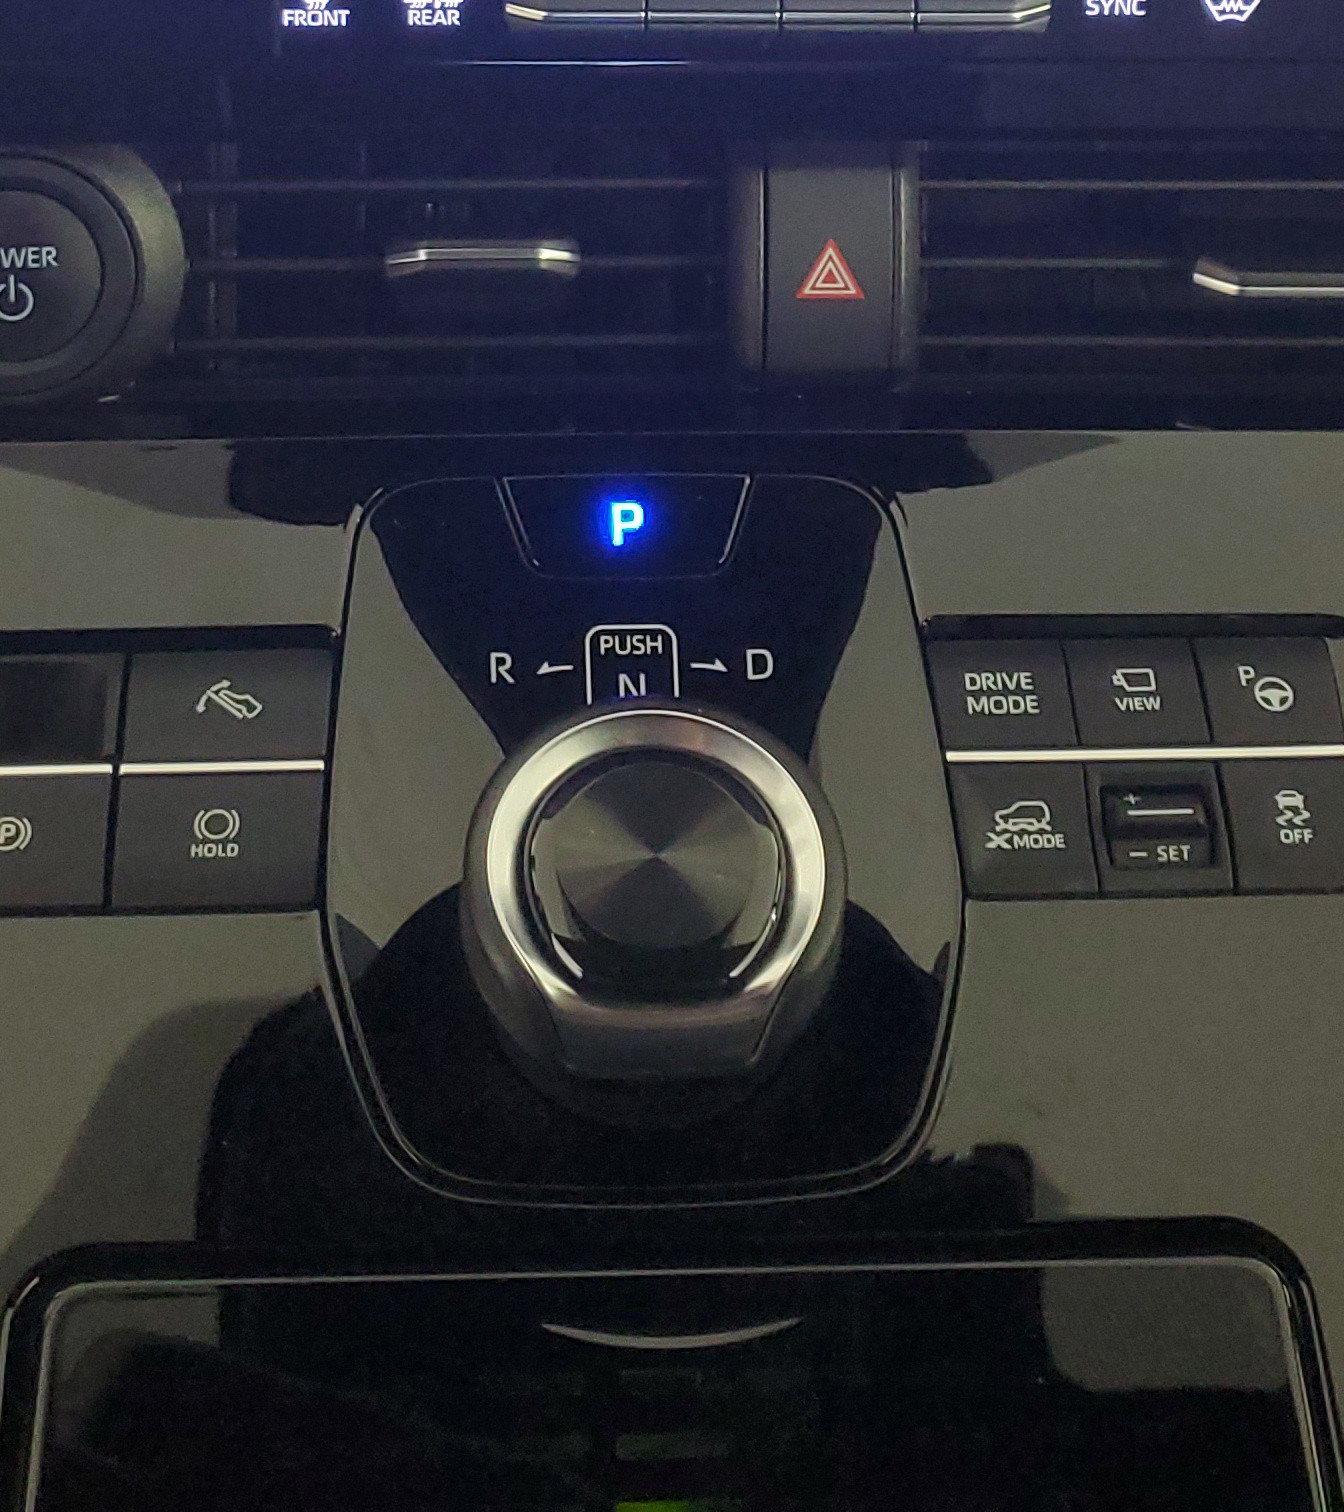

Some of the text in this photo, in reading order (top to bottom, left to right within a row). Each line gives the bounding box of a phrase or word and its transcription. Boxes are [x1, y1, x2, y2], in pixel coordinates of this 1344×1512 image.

[282, 9, 350, 27] FRONT
[408, 10, 461, 26] REAR
[610, 499, 644, 546] P
[599, 634, 663, 655] PUSH
[489, 648, 774, 684] R D
[1237, 665, 1255, 687] P
[618, 673, 647, 698] N
[964, 671, 1034, 692] DRIVE
[966, 695, 1041, 715] MODE
[1114, 696, 1161, 711] VIEW
[1279, 828, 1313, 844] OFF
[190, 842, 239, 858] HOLD
[1156, 844, 1192, 862] SET
